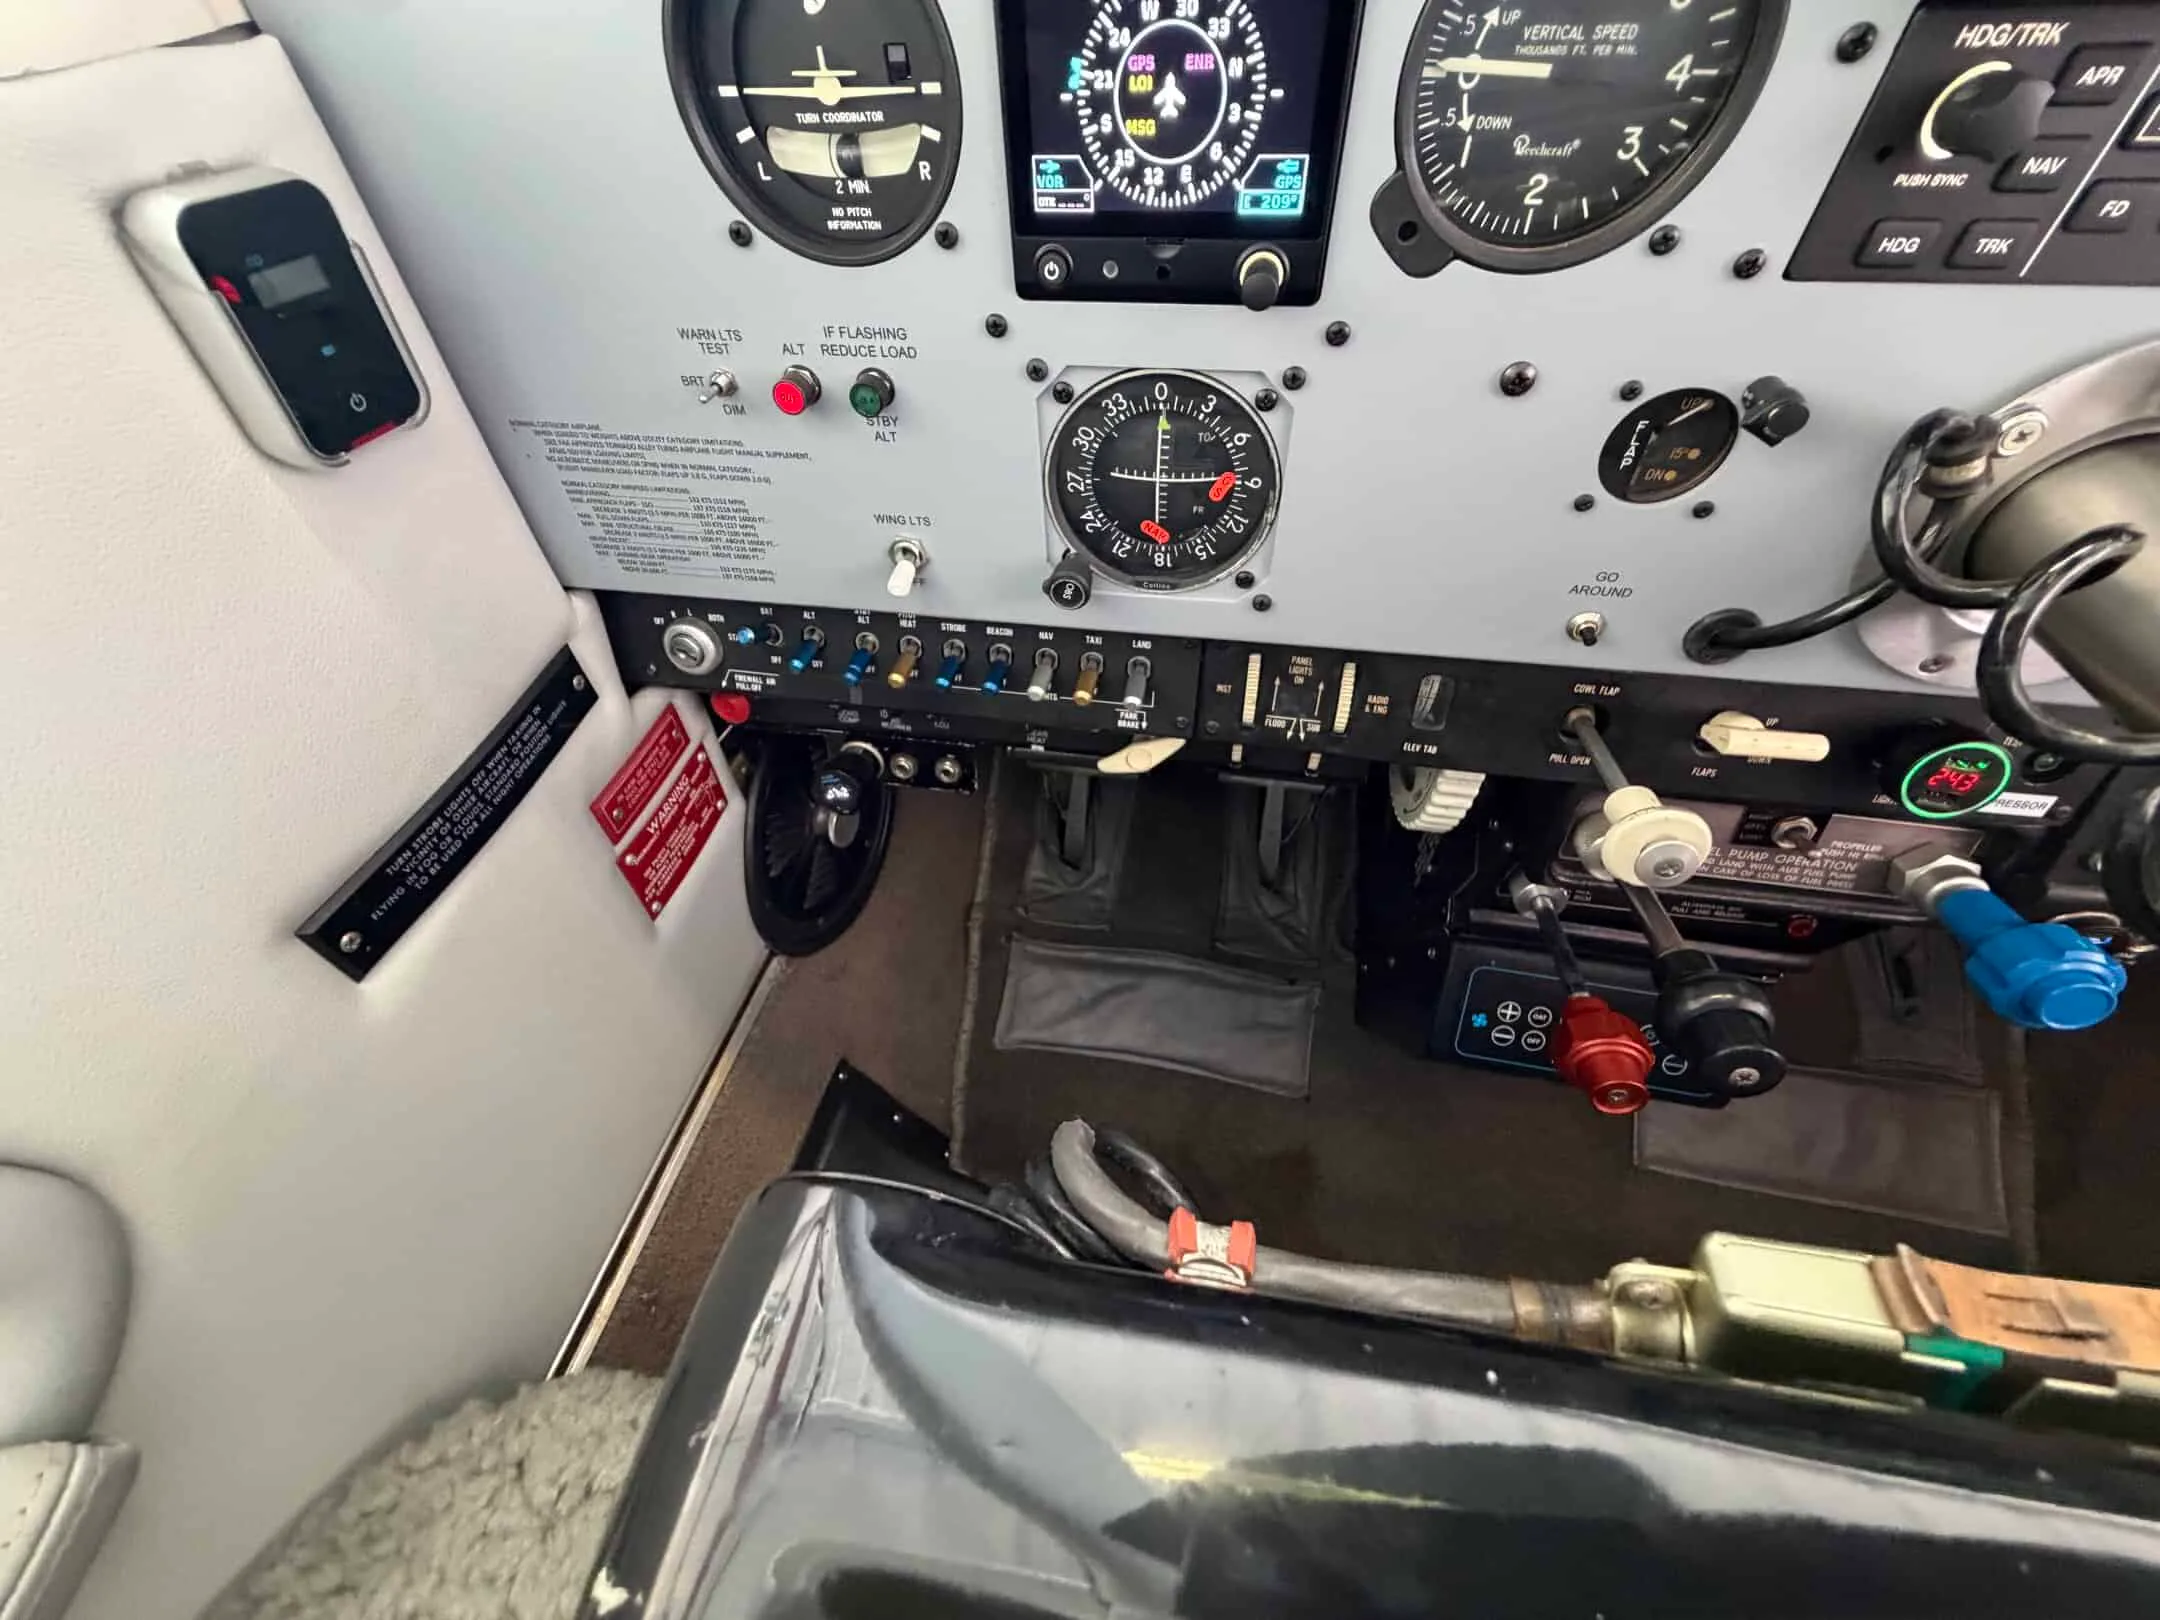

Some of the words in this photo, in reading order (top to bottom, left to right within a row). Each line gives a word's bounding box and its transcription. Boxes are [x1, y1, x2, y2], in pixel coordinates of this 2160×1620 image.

[1502, 10, 1520, 25] UP
[1208, 17, 1230, 38] 33
[1523, 25, 1585, 41] VERTICAL
[1593, 24, 1639, 40] SPEED
[1955, 22, 2070, 48] HDG/TRK
[1515, 45, 1567, 56] THOUSANDS
[1593, 45, 1611, 56] PER
[1128, 54, 1155, 71] GPS
[1185, 53, 1214, 70] ENR
[1093, 70, 1114, 89] 21
[1665, 54, 1695, 92] 4
[2076, 66, 2125, 86] APR
[796, 113, 819, 123] TURN
[823, 112, 883, 122] COORDINATOR
[1228, 103, 1240, 123] 3
[1476, 116, 1512, 129] DOWN
[1617, 126, 1643, 161] 3
[758, 162, 772, 181] L
[919, 161, 932, 180] R
[2022, 157, 2066, 175] NAV
[836, 181, 843, 194] 2
[1037, 174, 1064, 188] VOR
[1275, 174, 1301, 188] GPS
[1893, 173, 1929, 187] PUSH
[1931, 174, 1968, 187] SYNC
[1523, 174, 1549, 206] 2
[832, 207, 844, 217] NO
[847, 207, 871, 217] PITCH
[2099, 200, 2130, 217] FD
[827, 221, 881, 231] INFORMATION
[1878, 237, 1921, 253] HDG
[1975, 239, 2014, 254] TRK
[677, 328, 716, 341] WARN
[719, 329, 743, 342] LTS
[823, 326, 835, 338] IF
[838, 327, 908, 341] FLASHING
[699, 342, 730, 355] TEST
[782, 344, 805, 356] ALT
[820, 344, 877, 358] REDUCE
[881, 346, 917, 359] LOAD
[681, 376, 705, 386] BRT
[1155, 382, 1168, 400] 0
[723, 404, 746, 415] DIM
[1101, 393, 1128, 417] 33
[1201, 395, 1217, 413] 3
[866, 416, 898, 427] STBY
[875, 432, 897, 442] ALT
[1072, 427, 1095, 451] 30
[1066, 470, 1085, 493] 27
[1644, 469, 1665, 481] DN
[873, 513, 906, 525] WING
[909, 515, 931, 527] LTS
[1080, 510, 1102, 533] 24
[1226, 514, 1249, 533] 12
[1112, 541, 1132, 558] 21
[1194, 543, 1216, 561] 15
[1154, 552, 1173, 567] 18
[1595, 571, 1620, 583] GO
[1568, 585, 1633, 598] AROUND
[941, 622, 966, 632] STROBE
[1039, 632, 1054, 640] NAV
[1085, 635, 1102, 645] TAXI
[1132, 640, 1152, 649] LAND
[1292, 656, 1313, 667] PANEL
[1574, 683, 1596, 694] COWL
[1599, 686, 1621, 697] FLAP
[1265, 718, 1286, 728] FLOOD
[1766, 717, 1779, 726] UP
[1403, 742, 1421, 751] ELEV
[1423, 744, 1438, 754] TAB
[1549, 753, 1567, 763] PULL
[1570, 755, 1591, 765] OPEN
[1691, 767, 1718, 778] FLAPS
[1928, 767, 1980, 792] 243
[647, 774, 690, 834] WARNING
[1720, 859, 1746, 868] LAND
[1730, 849, 1769, 862] PUMP
[1775, 854, 1858, 872] OPERATION
